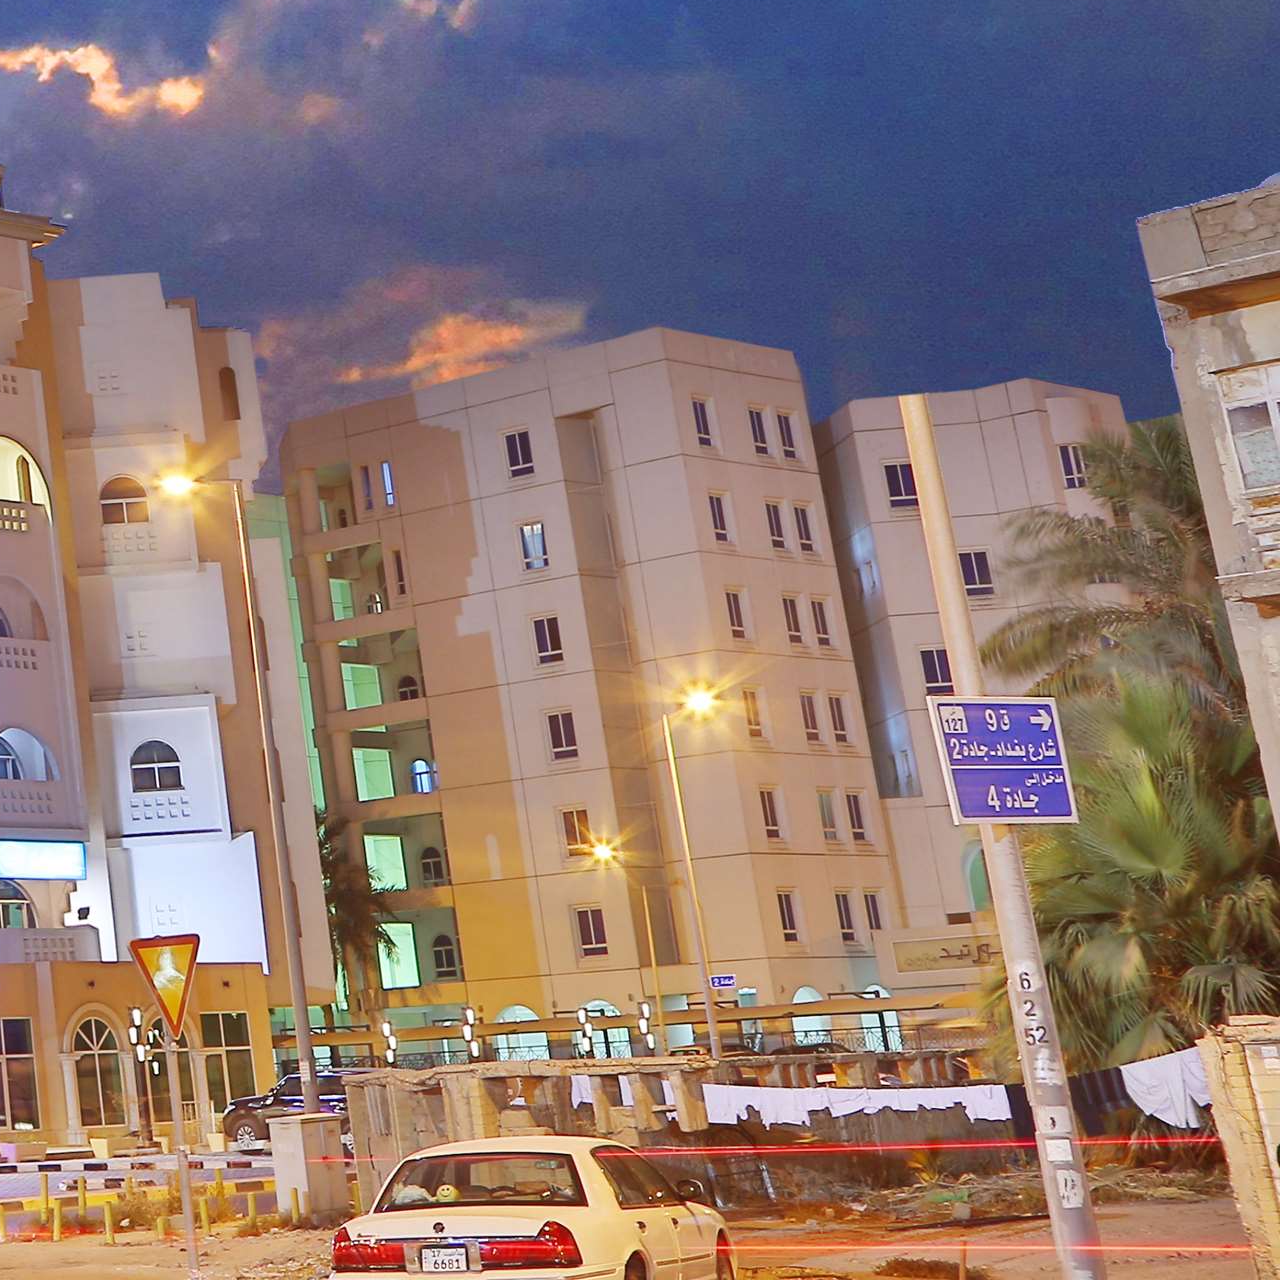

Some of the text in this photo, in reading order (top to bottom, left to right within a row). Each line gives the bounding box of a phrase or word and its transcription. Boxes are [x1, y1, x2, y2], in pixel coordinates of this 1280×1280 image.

[945, 719, 964, 731] 127
[985, 709, 997, 731] 9
[1028, 739, 1057, 761] شارع
[1042, 771, 1064, 785] مدخل
[987, 785, 1039, 813] جادة 4
[1019, 972, 1031, 990] 6
[1023, 999, 1036, 1017] 2
[1024, 1026, 1049, 1046] 52
[433, 1259, 461, 1270] 6681
